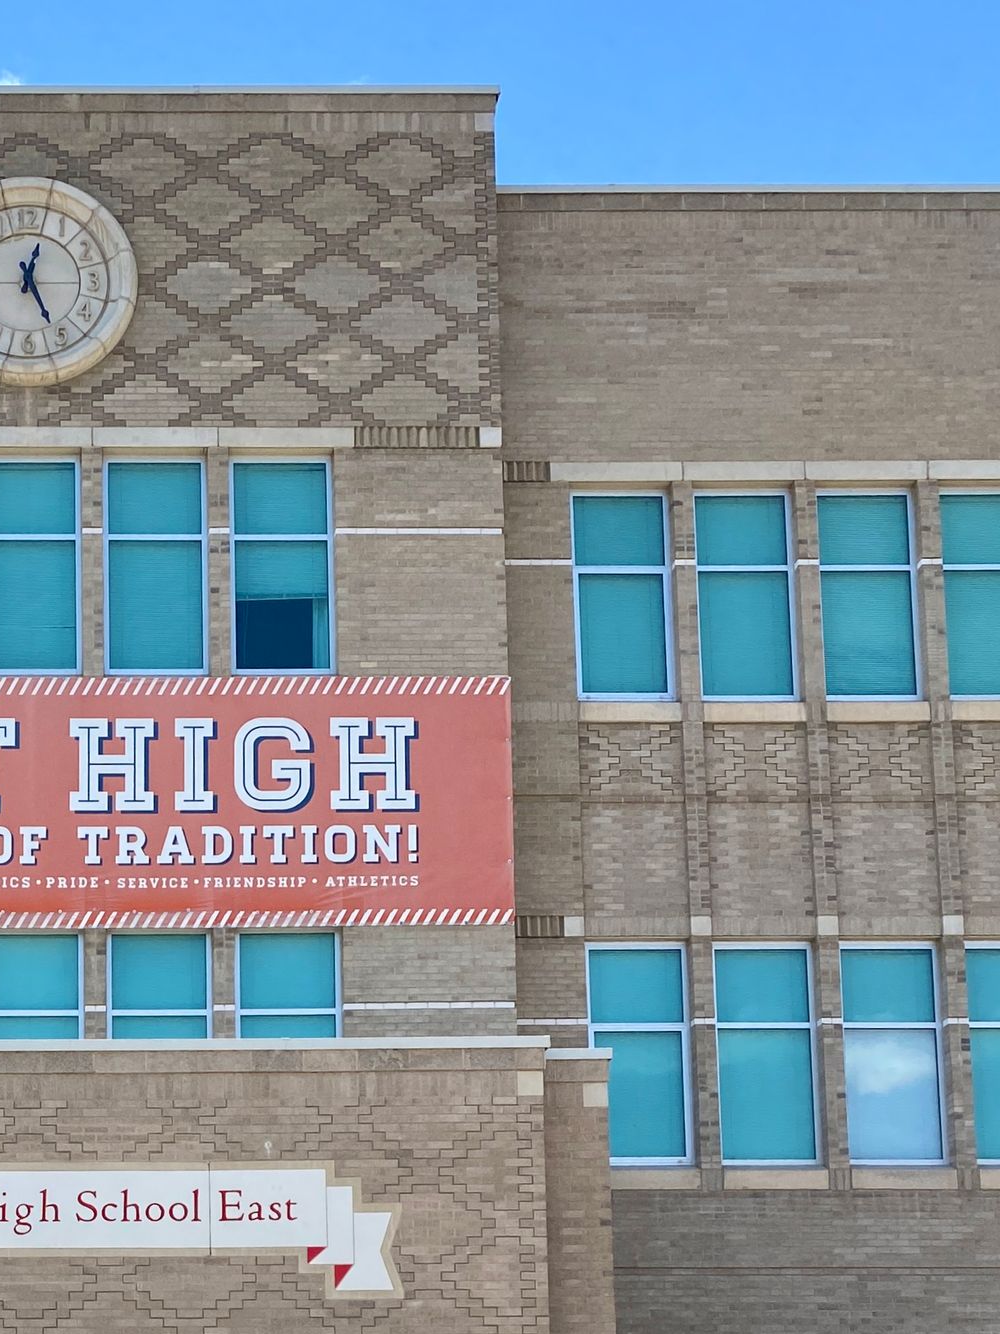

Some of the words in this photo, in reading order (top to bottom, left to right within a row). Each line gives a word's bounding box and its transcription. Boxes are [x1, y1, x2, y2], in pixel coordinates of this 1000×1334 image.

[18, 208, 40, 230] 12
[58, 216, 66, 237] 1
[79, 240, 92, 261] 2
[87, 271, 100, 292] 3
[77, 302, 92, 322] 4
[21, 332, 36, 354] 6
[55, 328, 68, 347] 5
[69, 716, 420, 814] HIGH
[77, 824, 419, 866] TRADITION!
[45, 876, 99, 889] PRIDE
[117, 877, 189, 890] SERVICE
[203, 876, 307, 889] FRIENDSHIP
[325, 875, 419, 888] ATHLETICS
[76, 1188, 202, 1222] School
[218, 1190, 298, 1222] East
